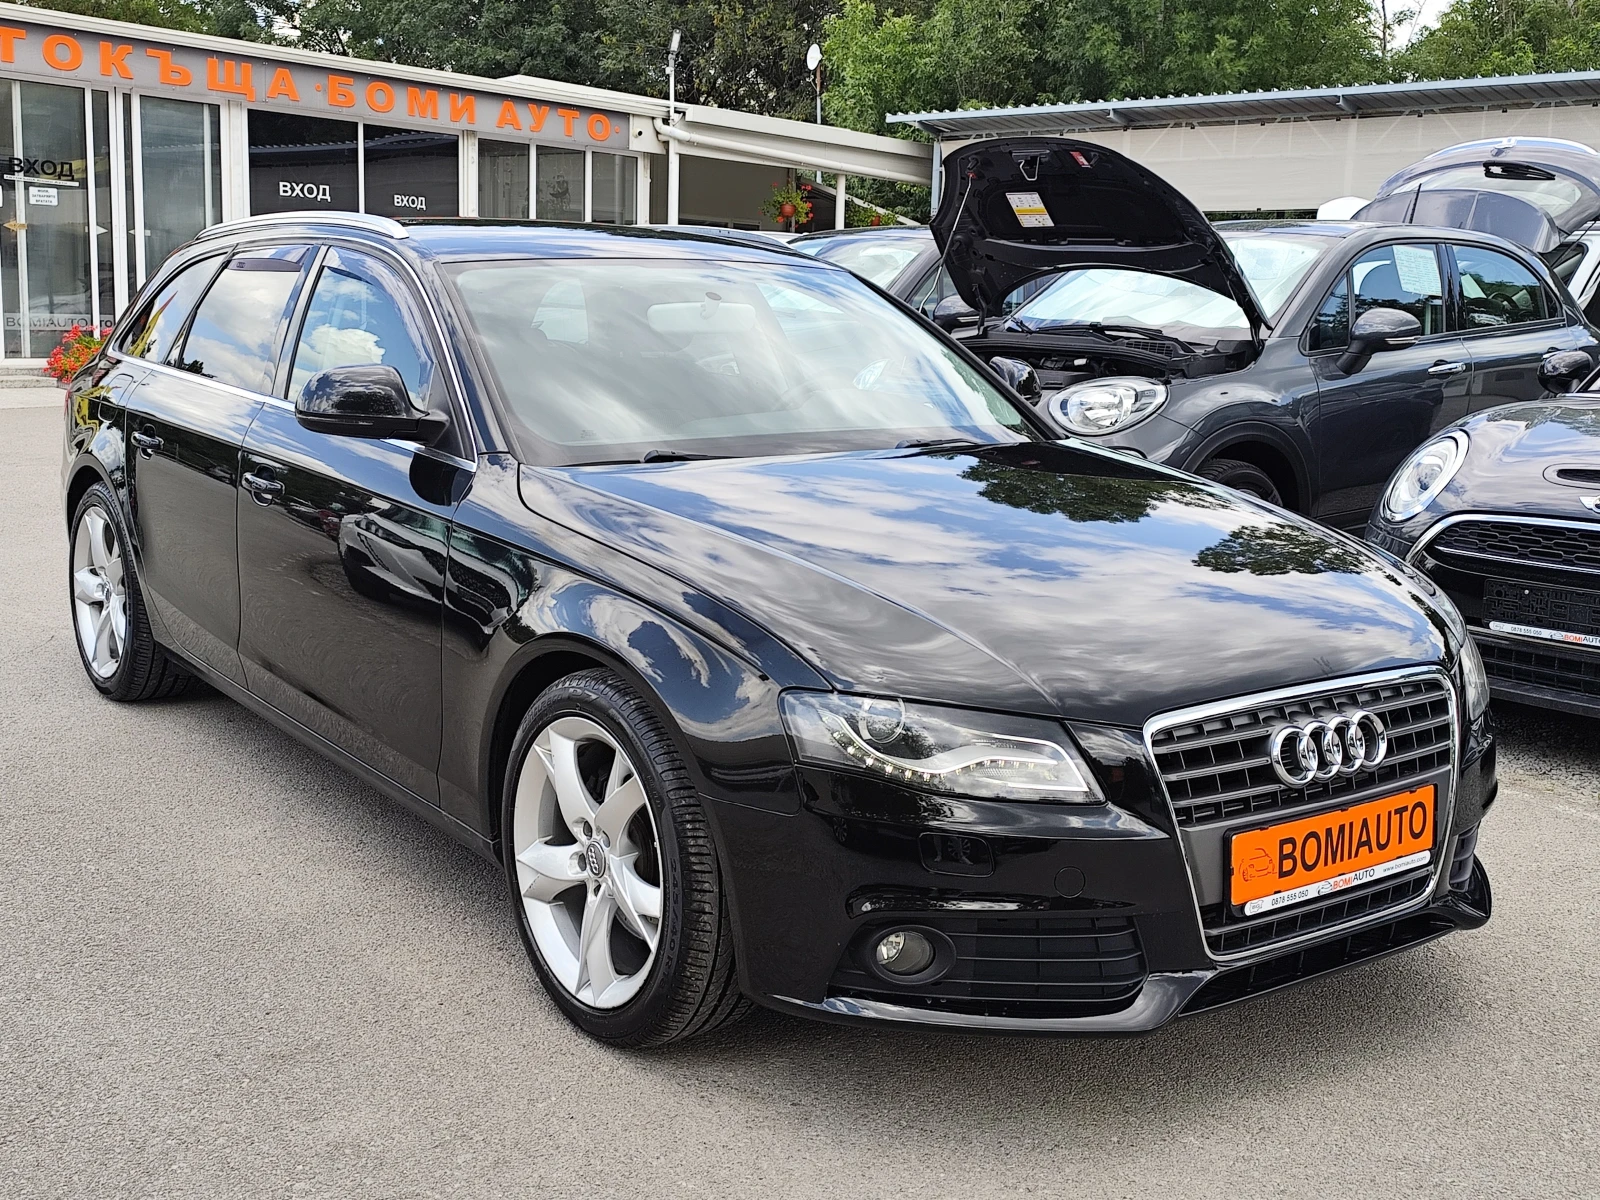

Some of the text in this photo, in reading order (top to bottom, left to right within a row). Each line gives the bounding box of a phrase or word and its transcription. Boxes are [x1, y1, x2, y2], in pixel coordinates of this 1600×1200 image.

[327, 74, 476, 125] БОМИ
[496, 99, 612, 142] АУТО
[9, 157, 75, 181] ВХОД
[279, 181, 331, 202] ВХОД
[394, 195, 426, 210] ВХОД
[1278, 800, 1427, 879] BOMIAUTO
[1271, 895, 1286, 907] 0878
[1286, 892, 1297, 903] 555
